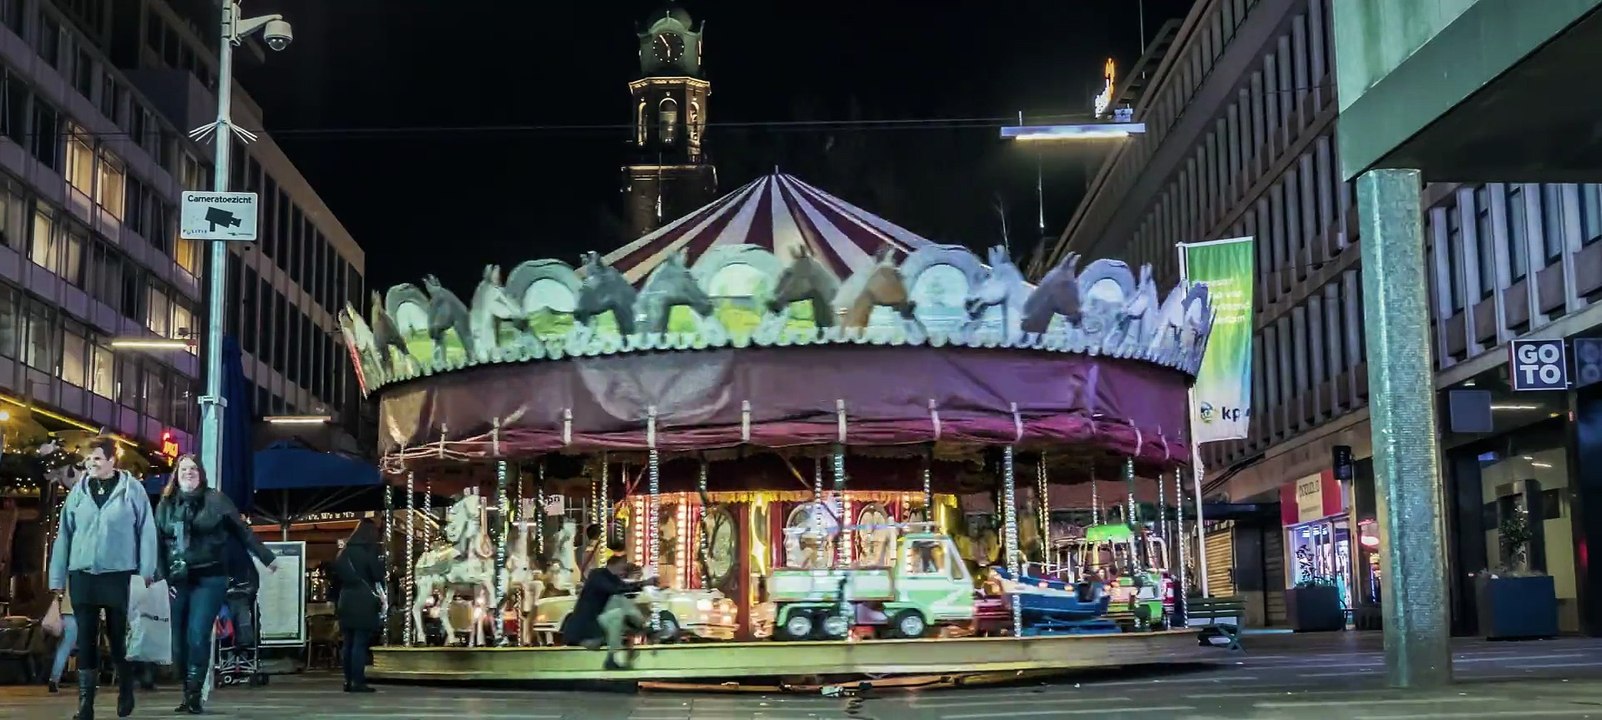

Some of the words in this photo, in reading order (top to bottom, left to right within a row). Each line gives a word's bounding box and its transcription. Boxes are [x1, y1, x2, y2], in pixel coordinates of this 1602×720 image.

[187, 194, 252, 204] Cameratoezicht
[1518, 343, 1560, 364] GO
[1519, 364, 1561, 385] TO
